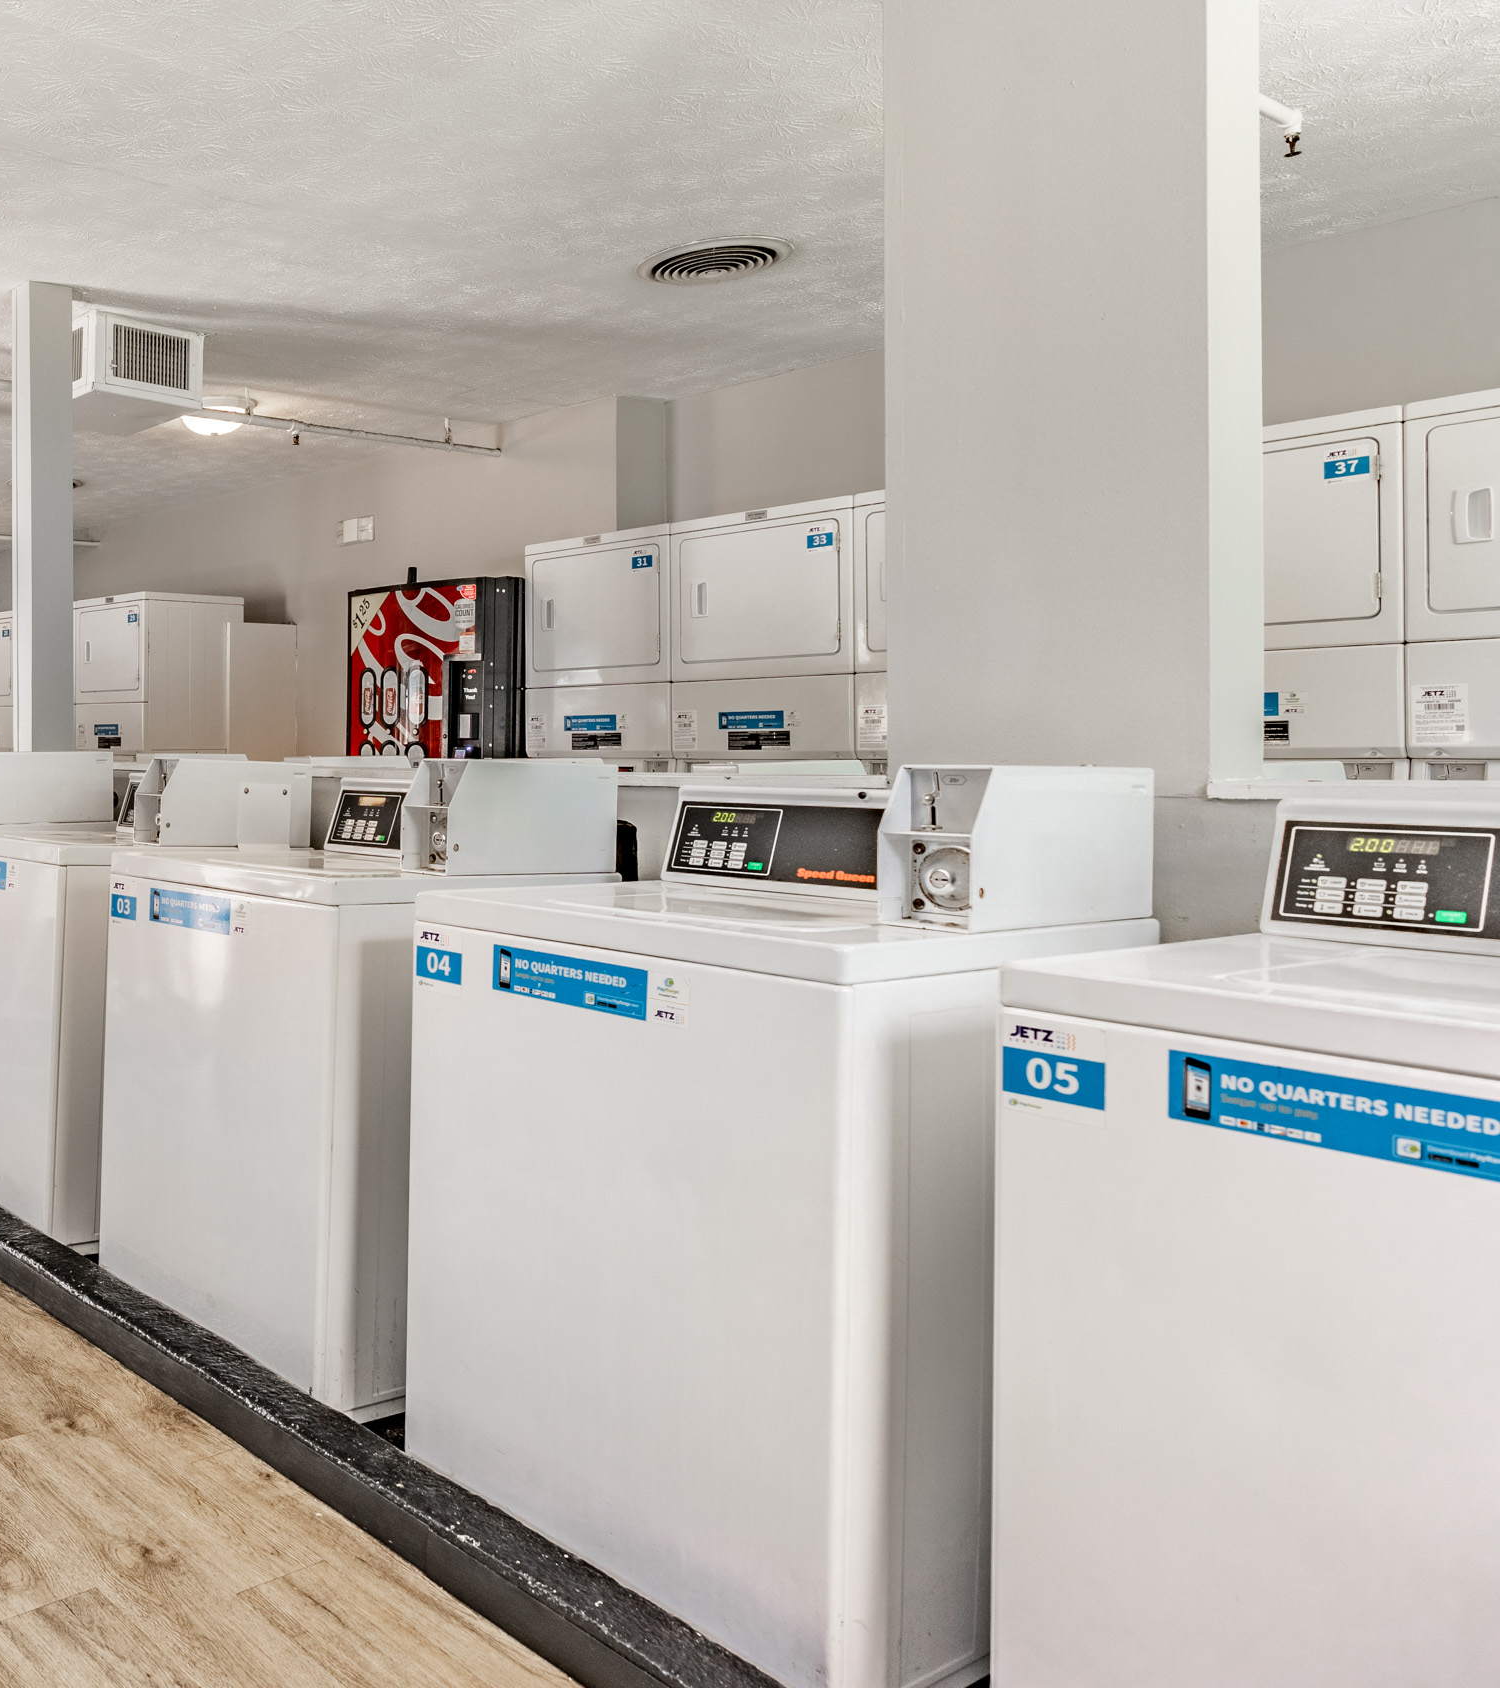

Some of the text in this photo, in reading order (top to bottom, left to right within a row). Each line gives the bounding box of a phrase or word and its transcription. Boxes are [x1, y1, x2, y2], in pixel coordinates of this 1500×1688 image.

[1334, 460, 1359, 474] 37
[812, 534, 827, 546] 33
[636, 557, 648, 566] 31
[352, 598, 370, 629] $1.25
[712, 812, 736, 822] 2.00
[1350, 838, 1395, 853] 2.00
[796, 868, 875, 883] Speed Queen
[116, 898, 131, 914] 03
[161, 897, 220, 913] NO QUARTERS NEEDED
[420, 931, 440, 942] JETZ
[426, 952, 451, 976] 04
[514, 958, 627, 988] NO QUARTERS NEEDED
[654, 1010, 674, 1020] JETZ
[1010, 1025, 1054, 1042] JETZ
[1026, 1057, 1080, 1095] 05
[1220, 1074, 1500, 1136] NO QUARTERS NEEDED
